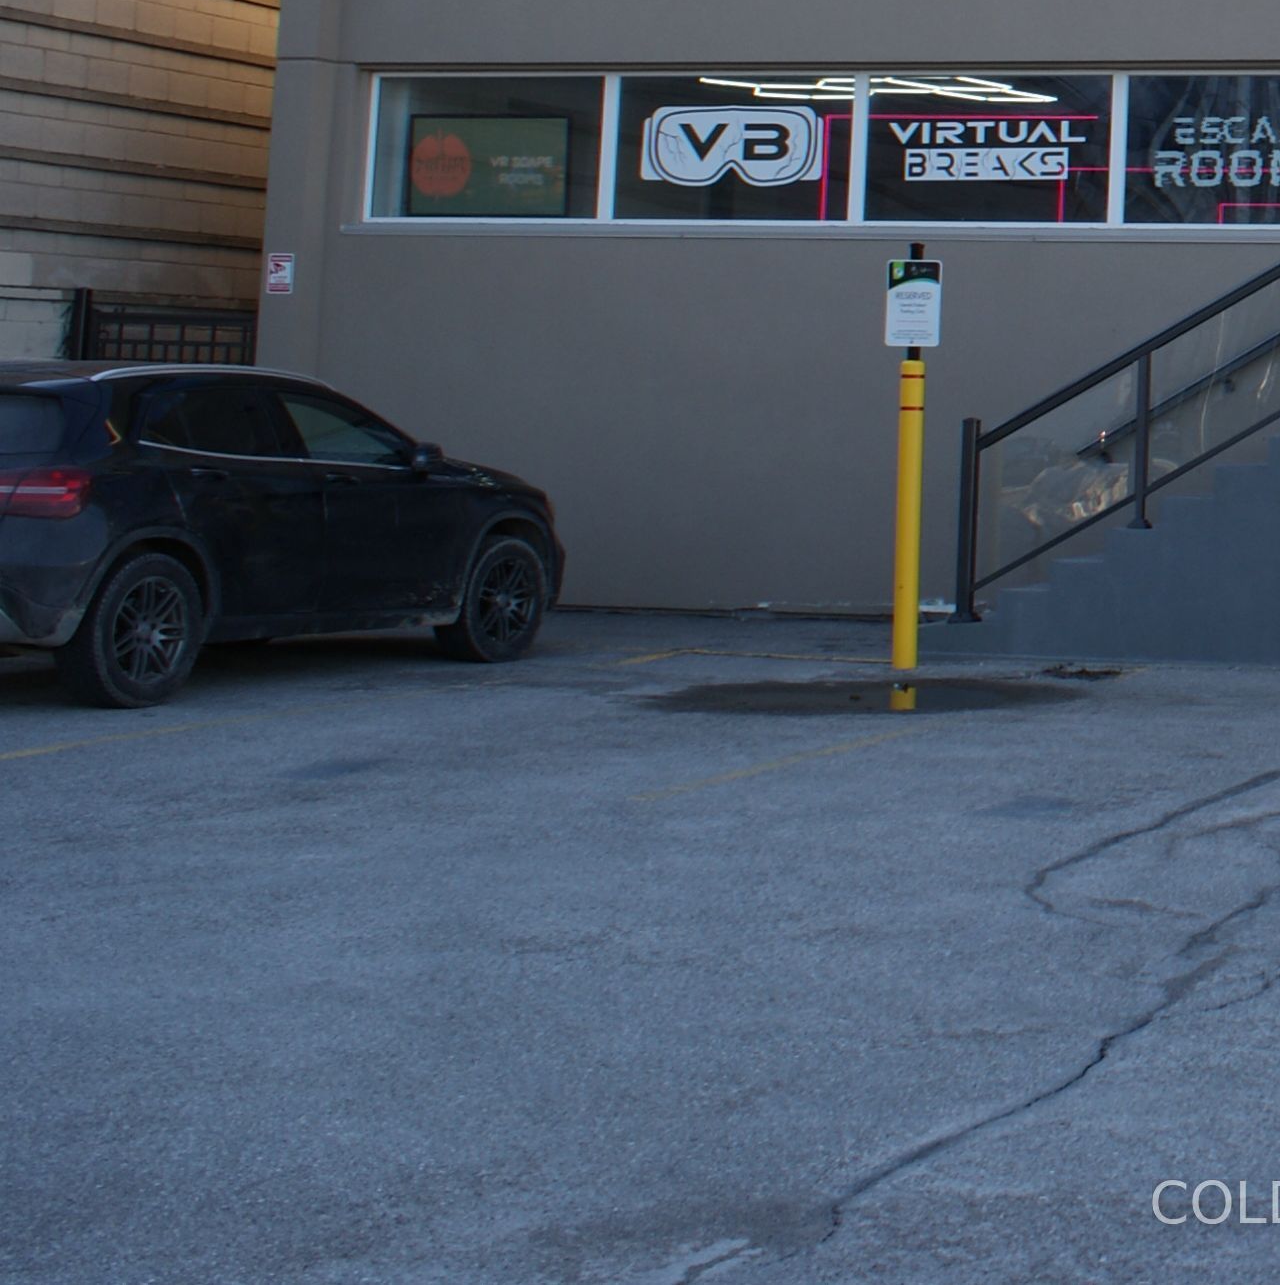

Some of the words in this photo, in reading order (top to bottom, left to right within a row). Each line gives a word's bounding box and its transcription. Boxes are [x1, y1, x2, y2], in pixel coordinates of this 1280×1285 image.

[678, 122, 791, 162] VB
[888, 120, 1087, 145] VIRTUAL
[907, 151, 1066, 177] BREAKS
